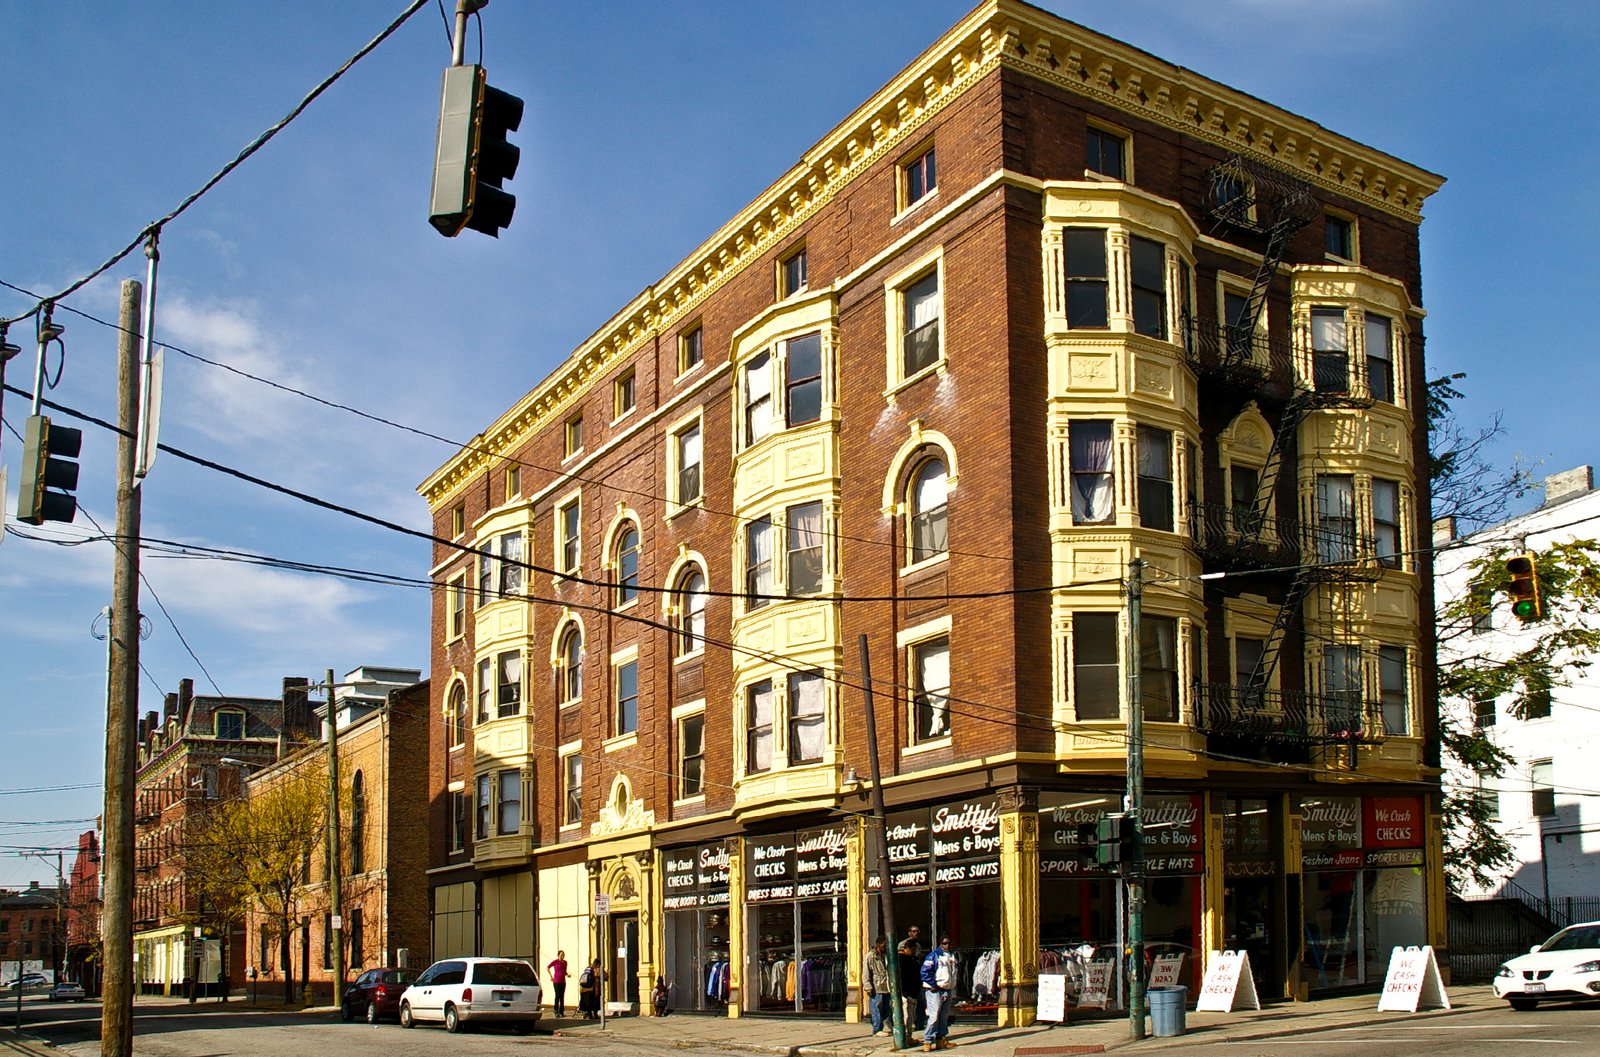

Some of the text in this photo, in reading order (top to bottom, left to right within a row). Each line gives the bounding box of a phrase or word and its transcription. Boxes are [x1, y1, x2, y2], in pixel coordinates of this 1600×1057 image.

[931, 802, 999, 834] Smitty's
[1053, 808, 1104, 823] We Cash
[1142, 801, 1198, 830] mitty's
[1301, 801, 1357, 828] Smitty's
[1375, 808, 1411, 822] We Cash
[893, 823, 917, 840] Cash
[1054, 830, 1087, 844] CHE
[1302, 829, 1358, 844] Mens & Boys
[1376, 827, 1411, 840] CHECKS
[796, 828, 848, 854] Smitty's
[934, 835, 1000, 856] Mens & Boys
[1145, 831, 1198, 848] ns & Boys
[754, 845, 785, 860] We Cash
[888, 843, 917, 860] ECKS
[1367, 852, 1421, 864] SPORTS WEAR
[667, 858, 694, 872] We Cash
[797, 855, 848, 872] Mens & Boys
[1144, 857, 1195, 870] YLE HATS
[1301, 854, 1360, 866] Fashion Jeans
[754, 862, 785, 877] CHECKS
[936, 862, 999, 882] DRESS SUITS
[668, 874, 694, 887] CHECKS
[699, 873, 712, 884] Mens
[713, 871, 719, 883] &
[895, 871, 927, 886] SHIRTS
[748, 886, 793, 900] DRESS SHOES
[797, 883, 821, 896] DRESS
[664, 896, 698, 909] WORK BOOTS
[700, 896, 707, 905] &
[1218, 964, 1232, 972] WE
[1400, 960, 1414, 968] WE
[1211, 974, 1232, 982] CASH
[1393, 972, 1417, 980] CASH
[1204, 985, 1234, 994] CHECKS
[1387, 983, 1418, 993] CHECKS
